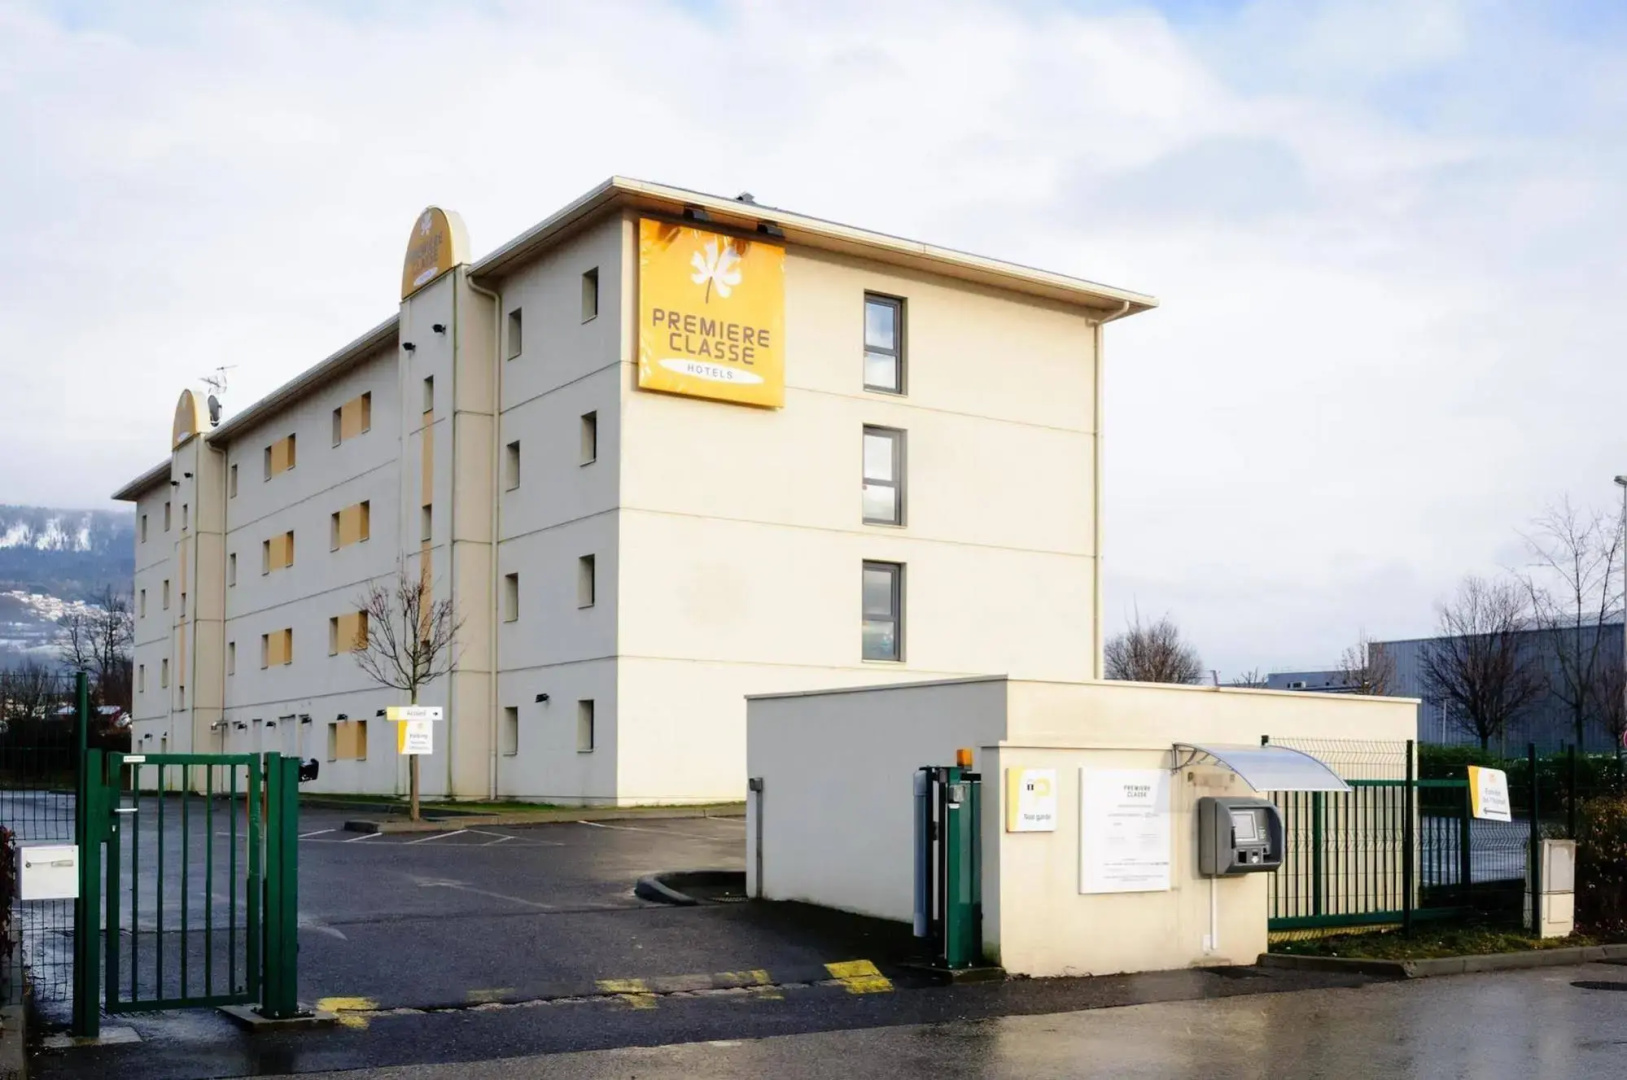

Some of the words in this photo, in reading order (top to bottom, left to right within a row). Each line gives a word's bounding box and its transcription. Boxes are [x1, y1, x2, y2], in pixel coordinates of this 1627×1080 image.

[652, 308, 770, 348] PREMIERE
[669, 332, 755, 365] CLASSE
[687, 363, 734, 380] HOTELS
[1123, 784, 1151, 792] PREMIERE
